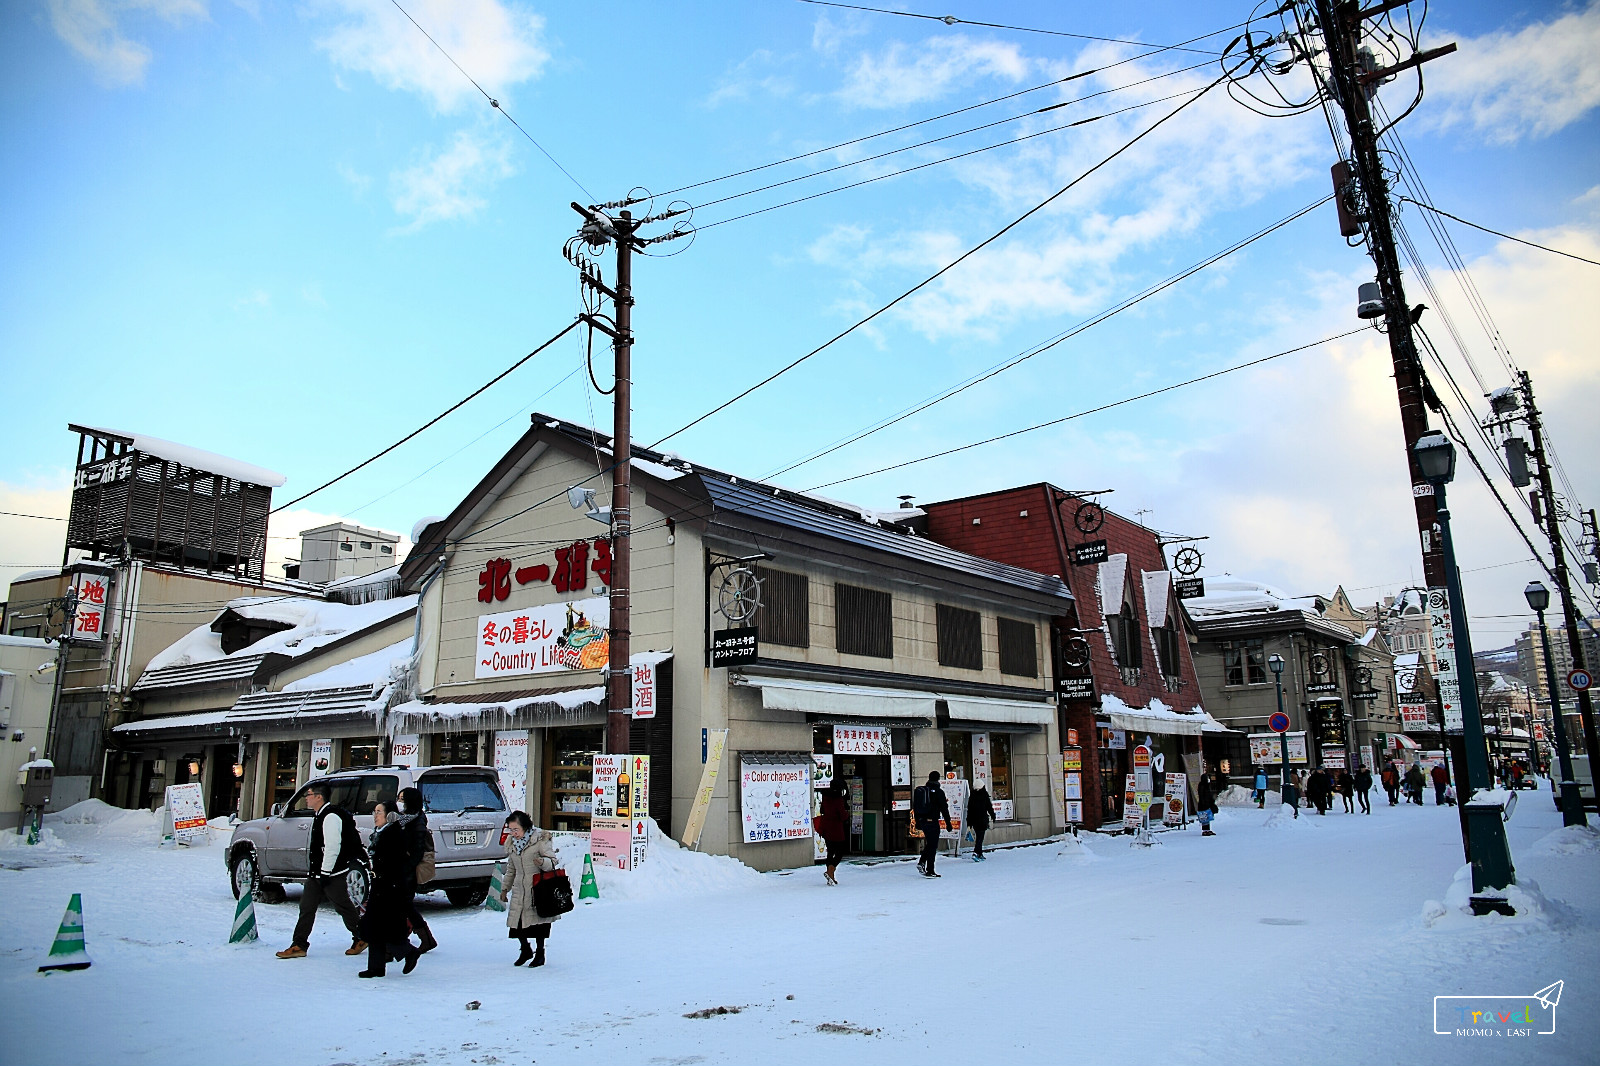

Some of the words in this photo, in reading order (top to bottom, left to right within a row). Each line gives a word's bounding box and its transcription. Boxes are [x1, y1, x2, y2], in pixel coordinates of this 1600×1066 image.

[74, 456, 132, 490] 北一硝子
[78, 580, 104, 633] 地酒
[482, 616, 552, 646] 冬の暮らし
[715, 648, 754, 658] カントリーフロア
[635, 664, 652, 707] 地酒
[1572, 675, 1588, 685] 40
[836, 729, 880, 740] 北海道的玻璃
[394, 744, 419, 756] 灯油ラン
[838, 742, 875, 752] GLASS
[596, 767, 618, 775] WHISKY
[751, 771, 769, 782] Color
[771, 771, 797, 782] changes
[598, 798, 609, 807] 北一
